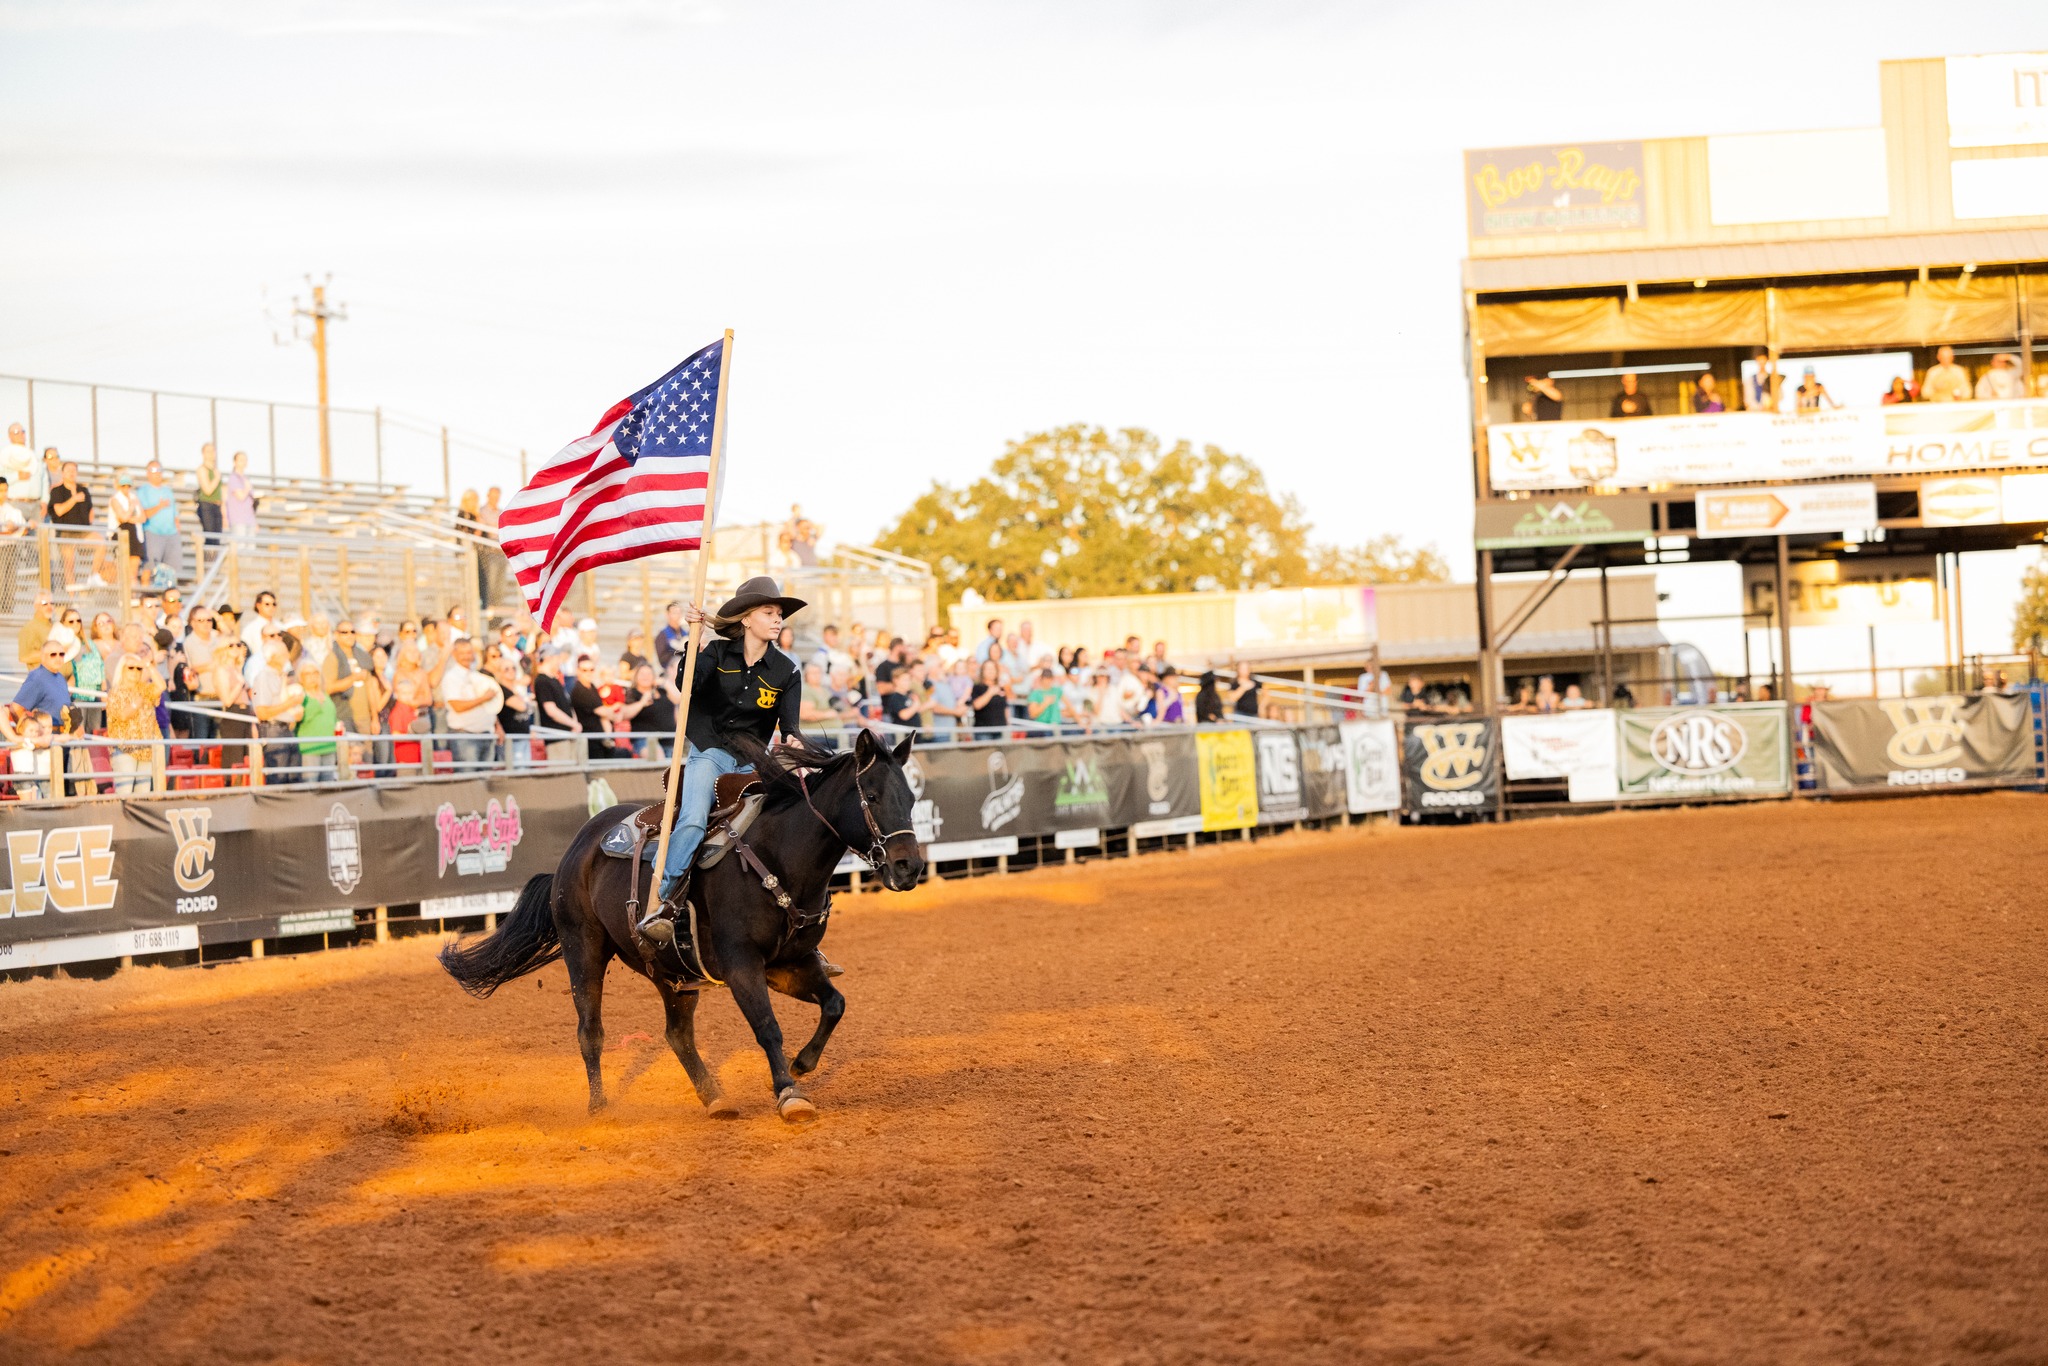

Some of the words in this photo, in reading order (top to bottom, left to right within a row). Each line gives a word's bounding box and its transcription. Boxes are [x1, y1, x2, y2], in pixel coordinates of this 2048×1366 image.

[1886, 440, 2011, 466] HOME
[1664, 716, 1734, 769] NRS
[1886, 766, 1967, 787] RODEO
[176, 895, 219, 914] RODEO
[133, 929, 180, 950] 817-688-1119
